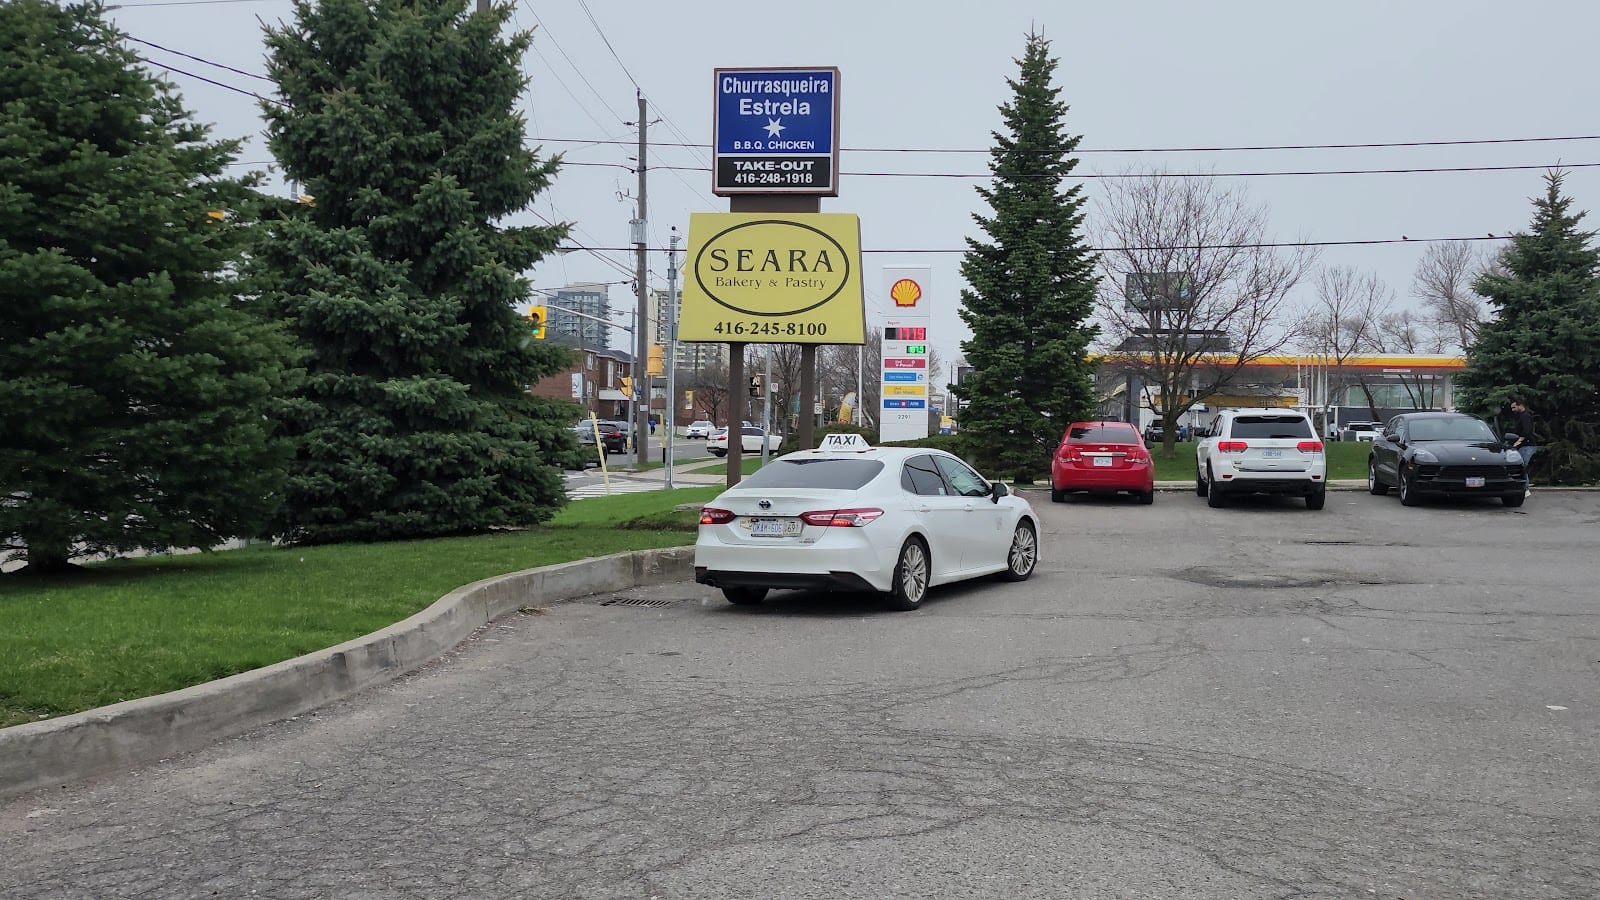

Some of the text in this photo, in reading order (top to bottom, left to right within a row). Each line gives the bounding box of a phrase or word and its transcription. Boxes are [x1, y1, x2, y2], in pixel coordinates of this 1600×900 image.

[722, 76, 829, 96] Churrasqueira
[739, 98, 810, 115] Estrela
[734, 140, 815, 150] B.B.Q. CHICKEN
[733, 161, 814, 171] TAKE-OUT
[734, 173, 813, 184] 416-248-1918
[710, 249, 834, 272] SEARA
[715, 276, 827, 290] Bakery & Pastry
[714, 321, 827, 336] 416-245-8100
[827, 435, 857, 446] TAXI
